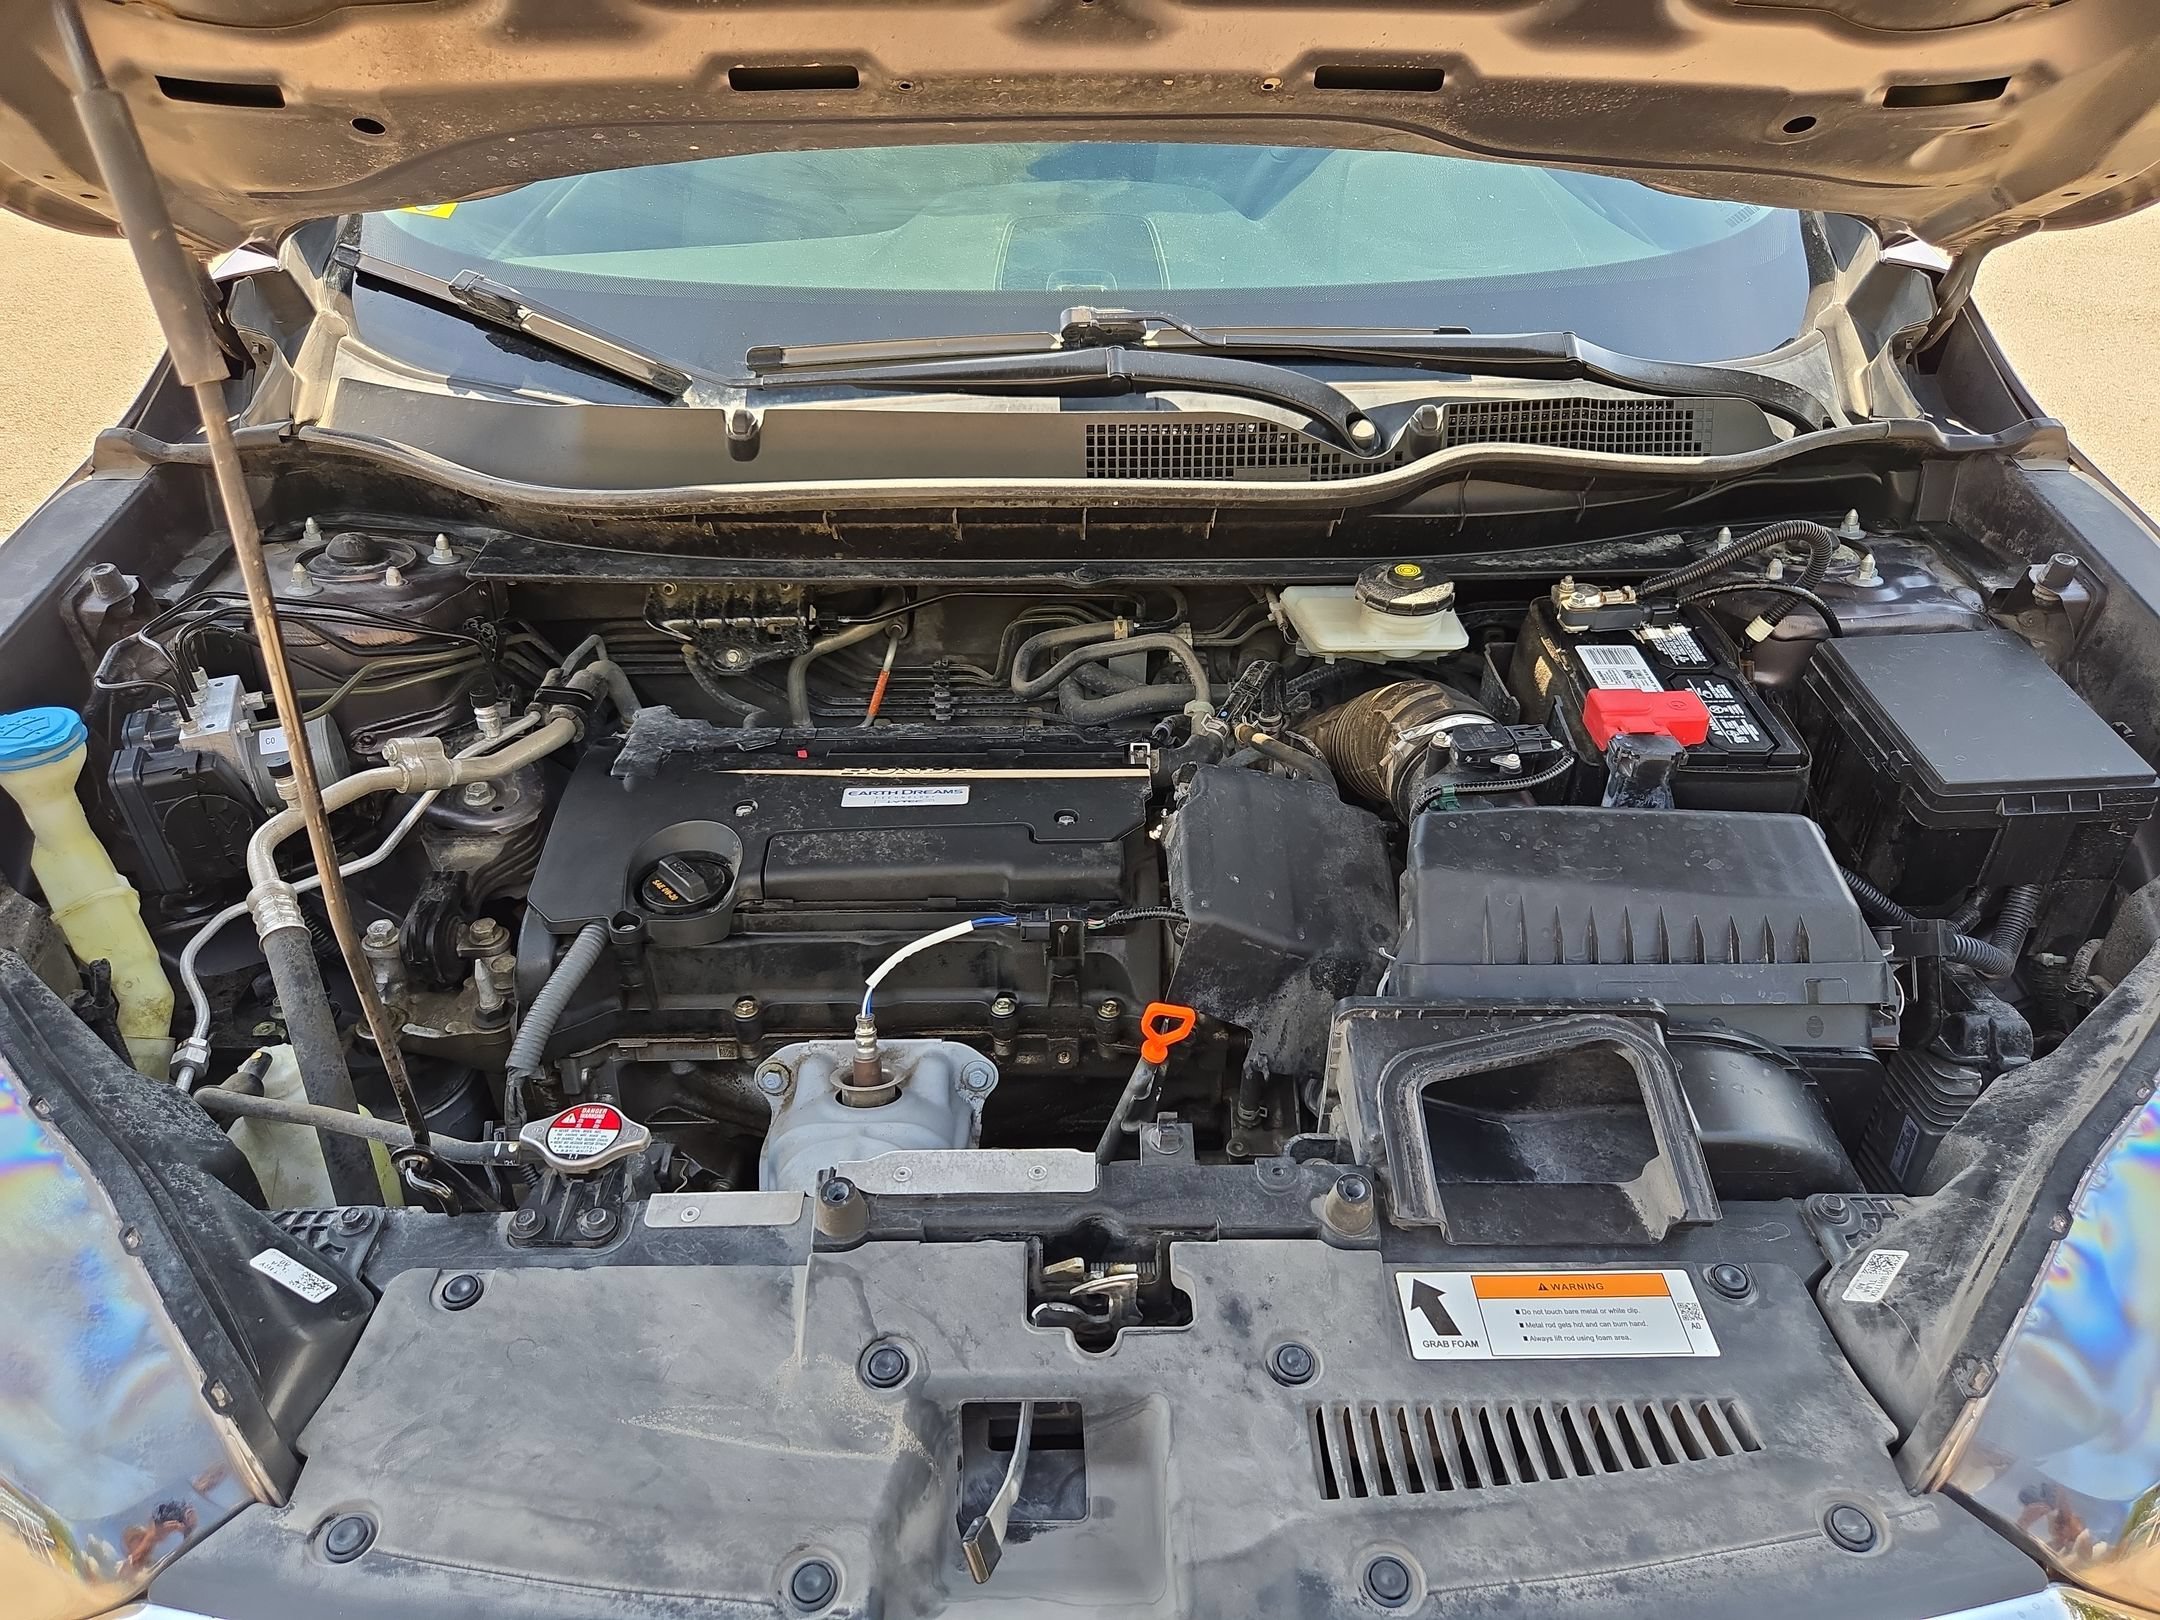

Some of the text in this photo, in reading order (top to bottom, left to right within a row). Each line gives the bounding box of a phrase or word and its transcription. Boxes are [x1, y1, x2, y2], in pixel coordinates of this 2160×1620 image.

[1550, 1282, 1604, 1291] WARNING
[1557, 1321, 1572, 1329] gets
[1529, 1335, 1553, 1343] Always
[1422, 1339, 1480, 1348] GRAB FOAM
